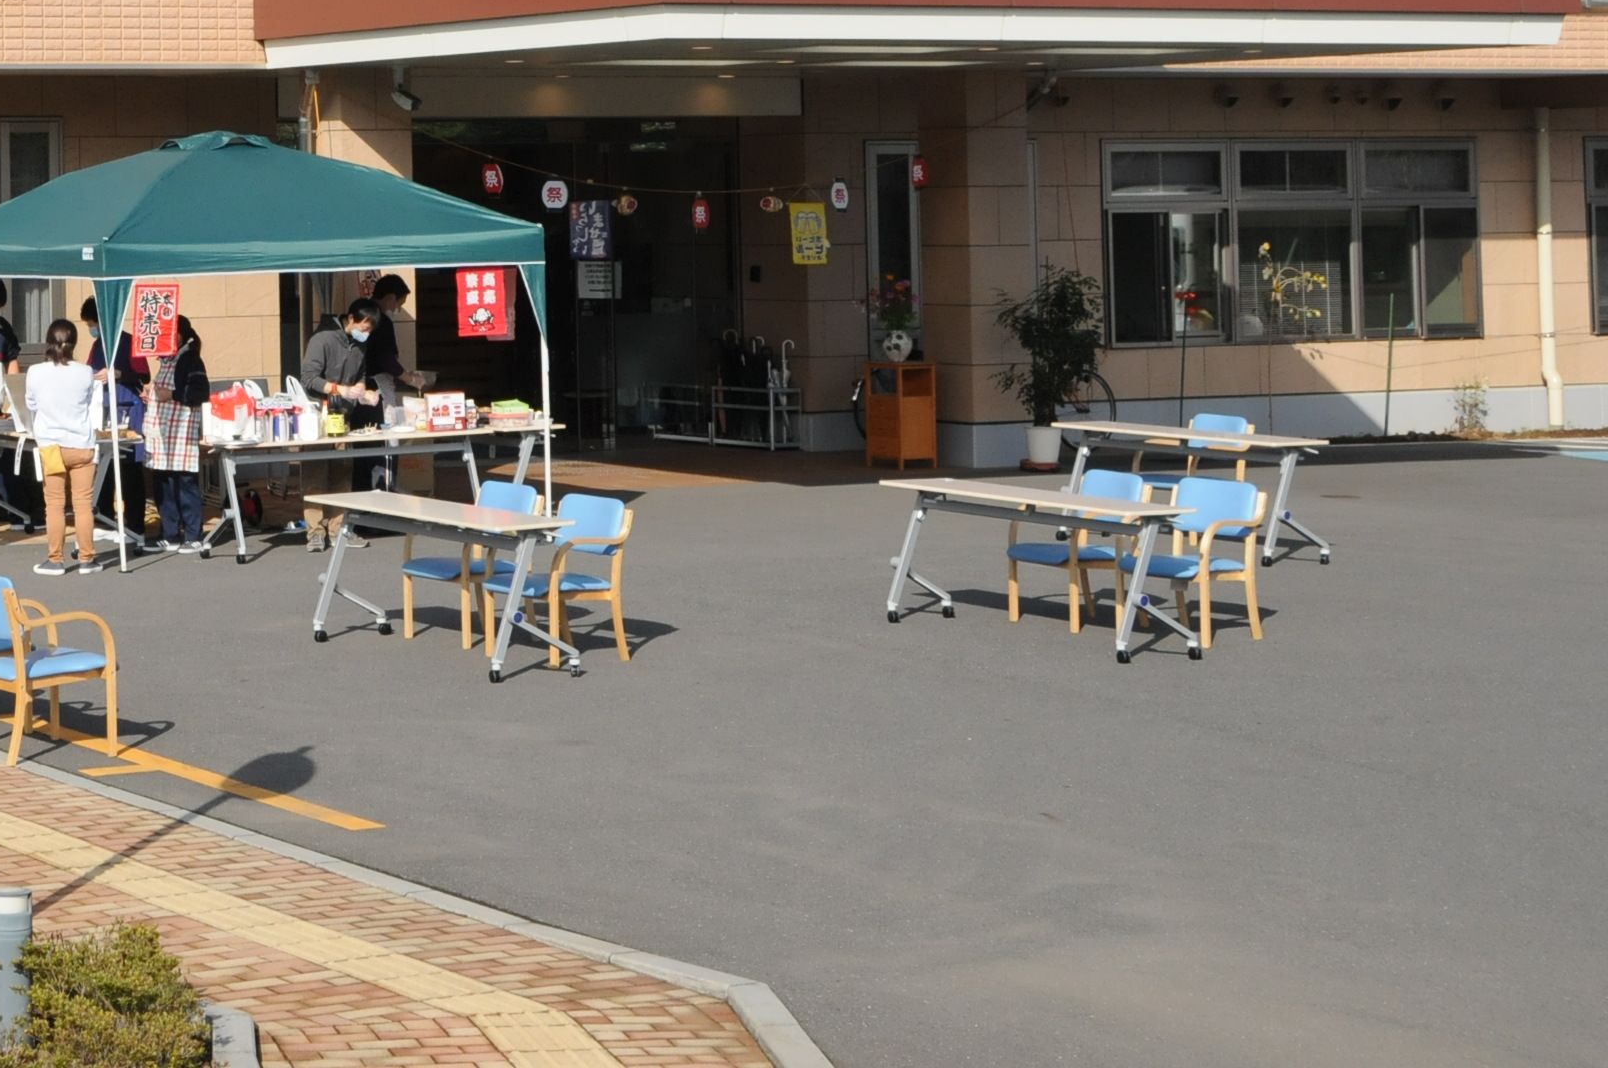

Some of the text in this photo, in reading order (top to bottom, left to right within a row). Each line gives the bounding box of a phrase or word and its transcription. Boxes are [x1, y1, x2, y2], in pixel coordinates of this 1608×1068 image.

[485, 170, 499, 188] 祭
[547, 186, 562, 203] 祭
[834, 188, 846, 204] 祭
[695, 206, 706, 223] 祭
[139, 289, 162, 351] 特売日
